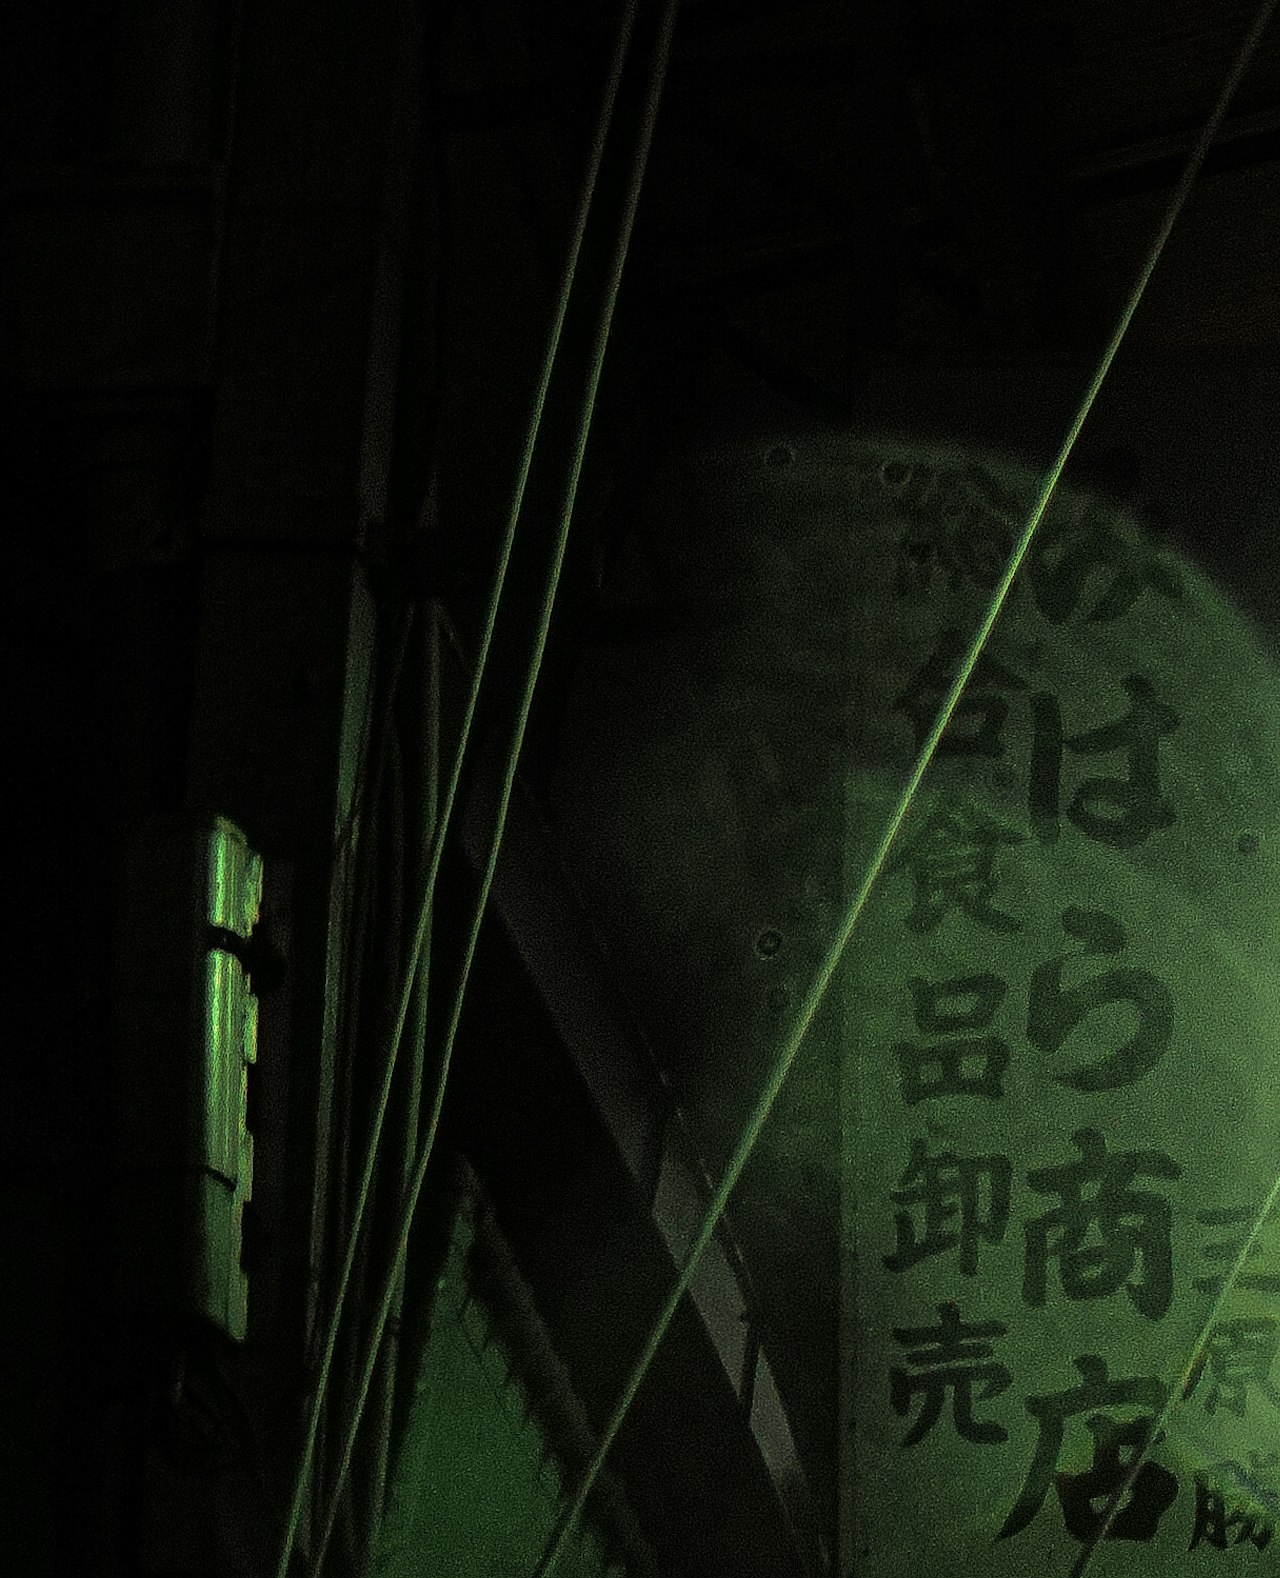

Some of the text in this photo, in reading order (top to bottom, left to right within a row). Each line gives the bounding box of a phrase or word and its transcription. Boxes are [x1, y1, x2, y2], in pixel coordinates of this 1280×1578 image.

[997, 505, 1183, 1542] みはら商店
